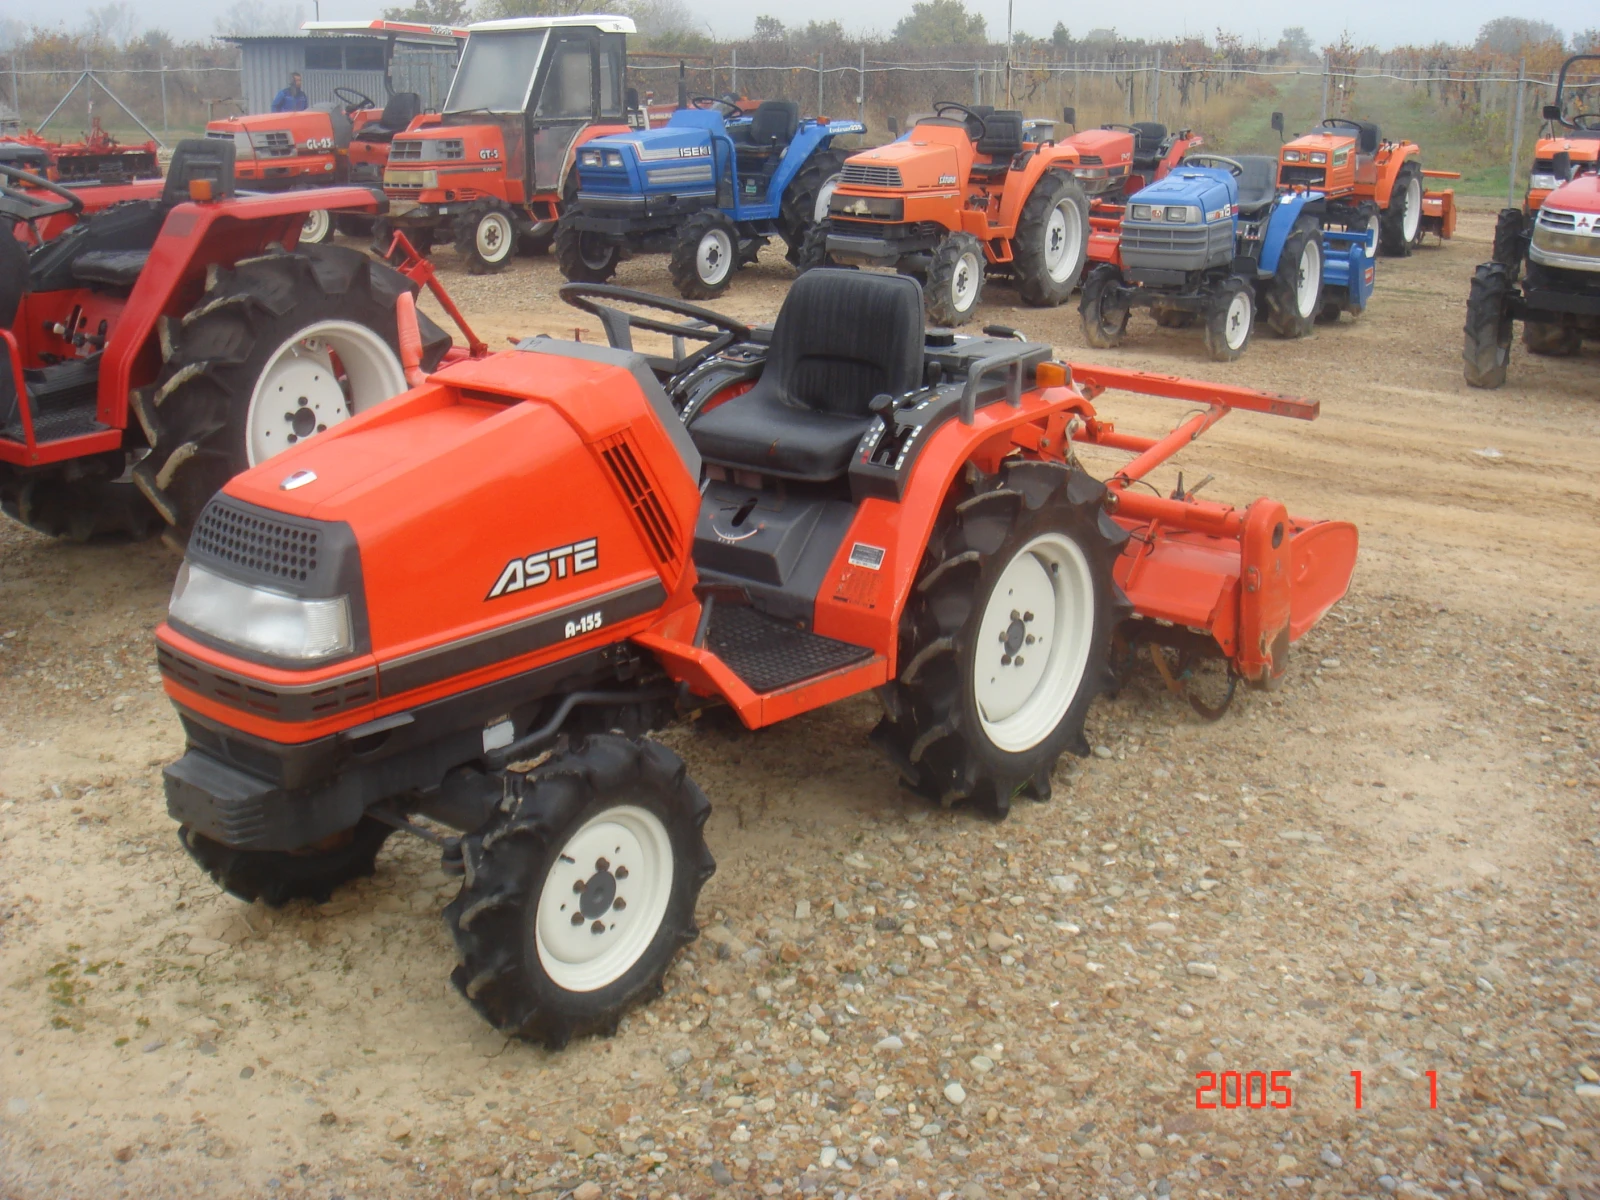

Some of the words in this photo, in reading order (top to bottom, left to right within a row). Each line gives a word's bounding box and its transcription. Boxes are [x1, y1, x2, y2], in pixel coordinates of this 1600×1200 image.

[479, 149, 499, 160] GT-5
[679, 146, 711, 157] ISEKI
[484, 537, 598, 602] ASTE
[565, 612, 603, 639] A-155
